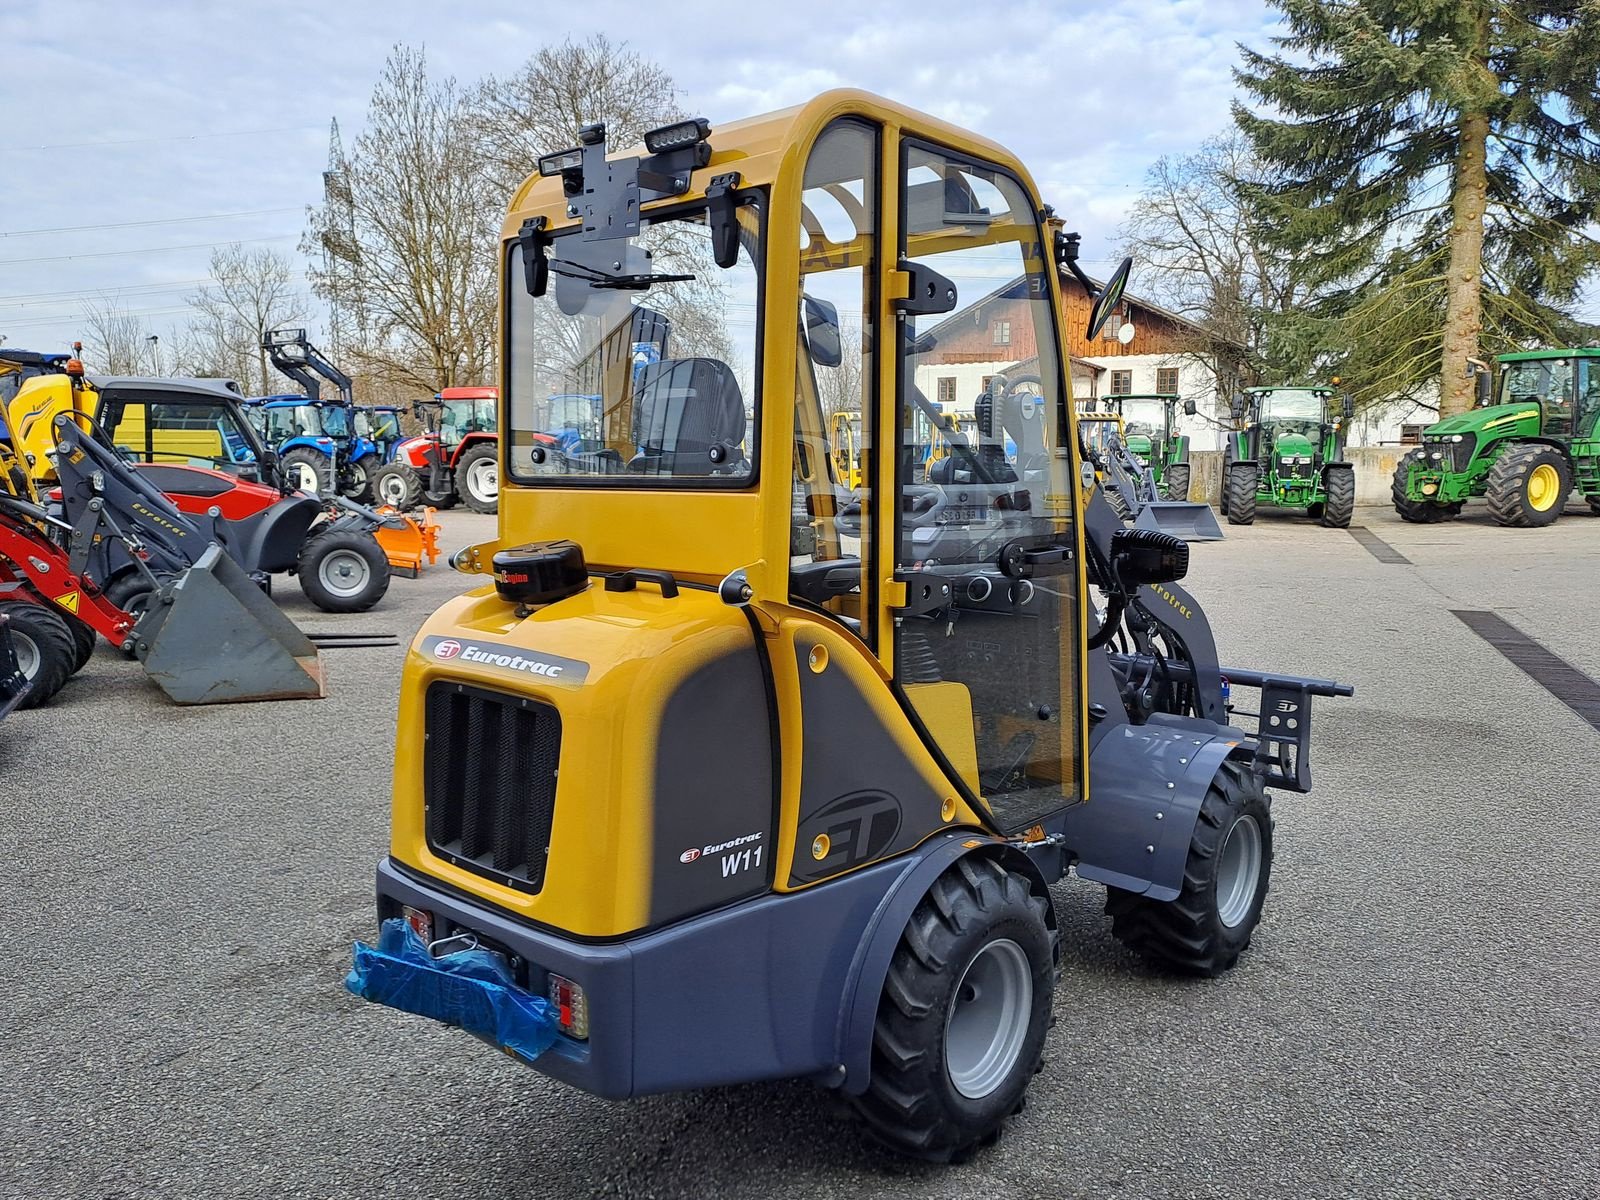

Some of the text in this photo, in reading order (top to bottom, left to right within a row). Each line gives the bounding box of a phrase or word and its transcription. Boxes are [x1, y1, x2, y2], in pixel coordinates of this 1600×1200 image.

[1150, 583, 1192, 619] urotrac
[460, 646, 563, 678] Eurotrac
[702, 831, 763, 856] Eurotrac
[721, 845, 763, 878] W11
